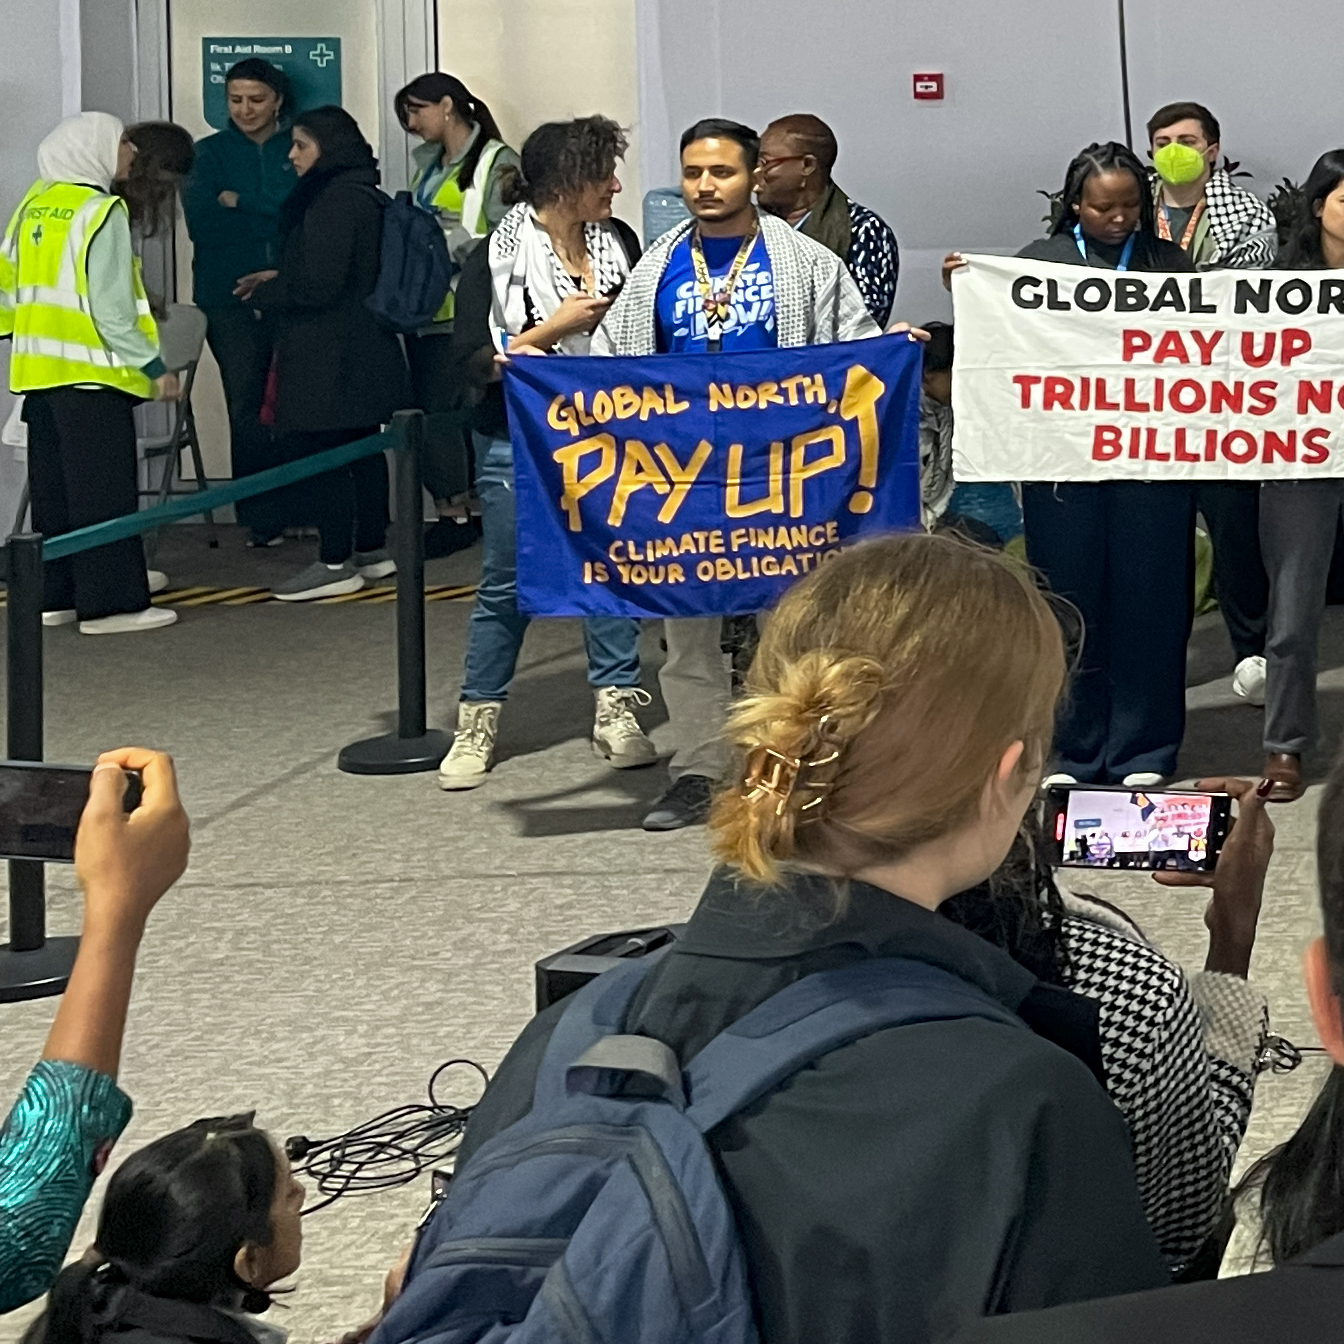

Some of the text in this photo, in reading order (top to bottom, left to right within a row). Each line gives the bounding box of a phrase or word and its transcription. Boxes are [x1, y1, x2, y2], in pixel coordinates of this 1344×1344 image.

[1011, 275, 1218, 314] GLOBAL
[1122, 327, 1312, 367] PAY UP
[547, 383, 689, 436] GLOBAL
[1012, 375, 1279, 415] TRILLIONS
[1091, 425, 1331, 464] BILLIONS
[553, 433, 712, 532] PAY
[609, 521, 840, 563] CLIMATE FINANCE
[583, 561, 609, 584] IS
[618, 561, 686, 585] YOUR
